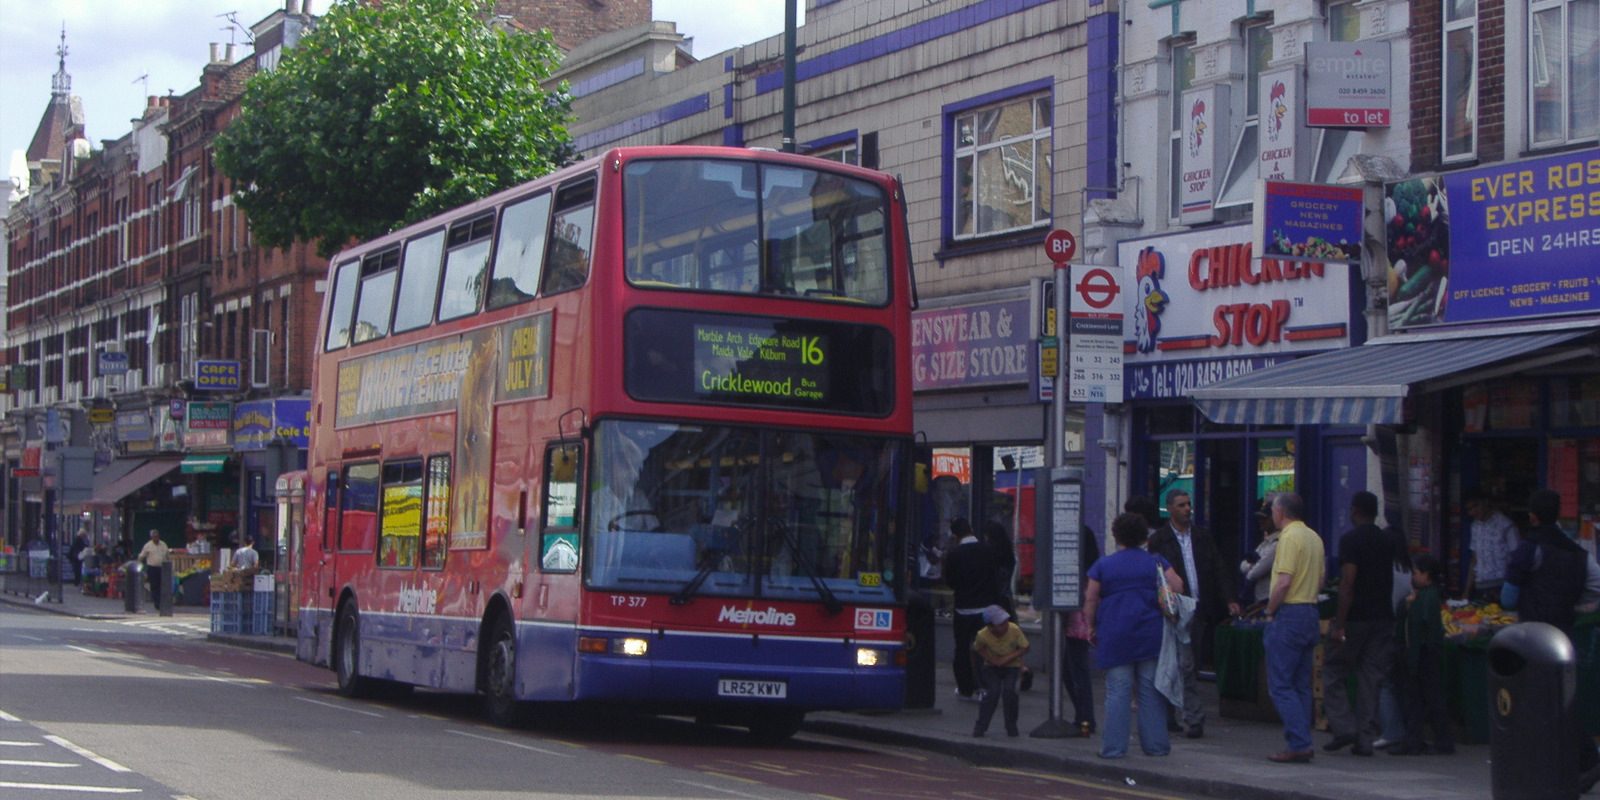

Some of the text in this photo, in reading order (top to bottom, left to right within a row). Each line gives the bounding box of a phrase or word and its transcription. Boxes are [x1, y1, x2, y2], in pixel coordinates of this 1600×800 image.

[1313, 56, 1385, 79] empire
[1344, 110, 1383, 124] to let
[1262, 147, 1293, 161] CHICKEN
[1183, 168, 1211, 182] CHICKEN
[1189, 181, 1206, 193] STOP
[1471, 170, 1535, 202] EVER
[1290, 200, 1339, 211] GROCERY
[1486, 191, 1600, 230] EXPRESS
[1300, 211, 1329, 220] NEWS
[1283, 220, 1344, 231] MAGAZINES
[1052, 240, 1071, 253] BP
[1488, 228, 1600, 257] OPEN 24HRS
[1454, 290, 1470, 300] OFF
[1471, 286, 1505, 298] LICENCE
[1512, 281, 1552, 294] GROCERY
[1558, 277, 1589, 289] FRUITS
[1509, 291, 1590, 308] NEWS MAGAZINES
[997, 308, 1013, 338] &
[1210, 299, 1290, 348] STOP
[698, 328, 800, 348] Marble Arch Edgware Road
[712, 344, 786, 361] Maida Vale Kilburn
[802, 336, 824, 365] 16
[912, 352, 927, 382] G
[931, 349, 966, 382] SIZE
[970, 344, 1027, 377] STORE
[1076, 355, 1084, 363] 16
[201, 365, 235, 374] CAFE
[505, 359, 532, 392] JULY
[199, 376, 237, 385] OPEN
[702, 370, 791, 396] Cricklewood
[801, 378, 816, 387] Bus
[1175, 363, 1194, 397] 020
[794, 388, 823, 399] Garage
[277, 426, 300, 437] Cafe
[861, 573, 881, 586] 620
[399, 580, 437, 614] Metroline
[610, 595, 647, 608] TP 377
[718, 605, 796, 627] Metroline
[722, 681, 782, 696] LR52 KWV
